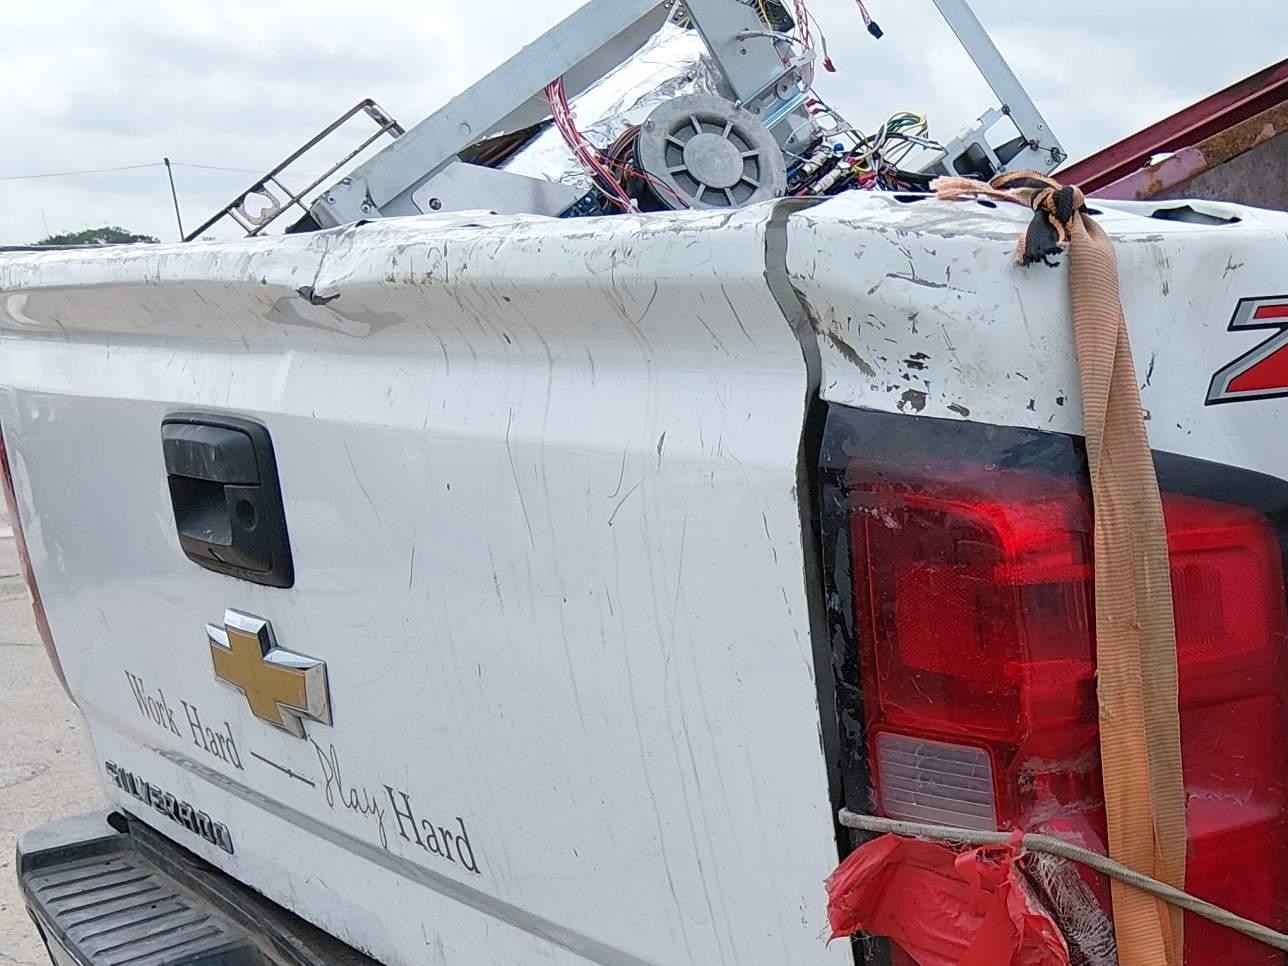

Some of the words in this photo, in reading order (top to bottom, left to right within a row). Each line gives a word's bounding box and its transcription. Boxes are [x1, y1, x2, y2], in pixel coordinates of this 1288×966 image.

[104, 759, 236, 856] SILVERADO
[123, 669, 183, 738] Work
[180, 699, 245, 771] Hard
[383, 783, 482, 875] Hard
